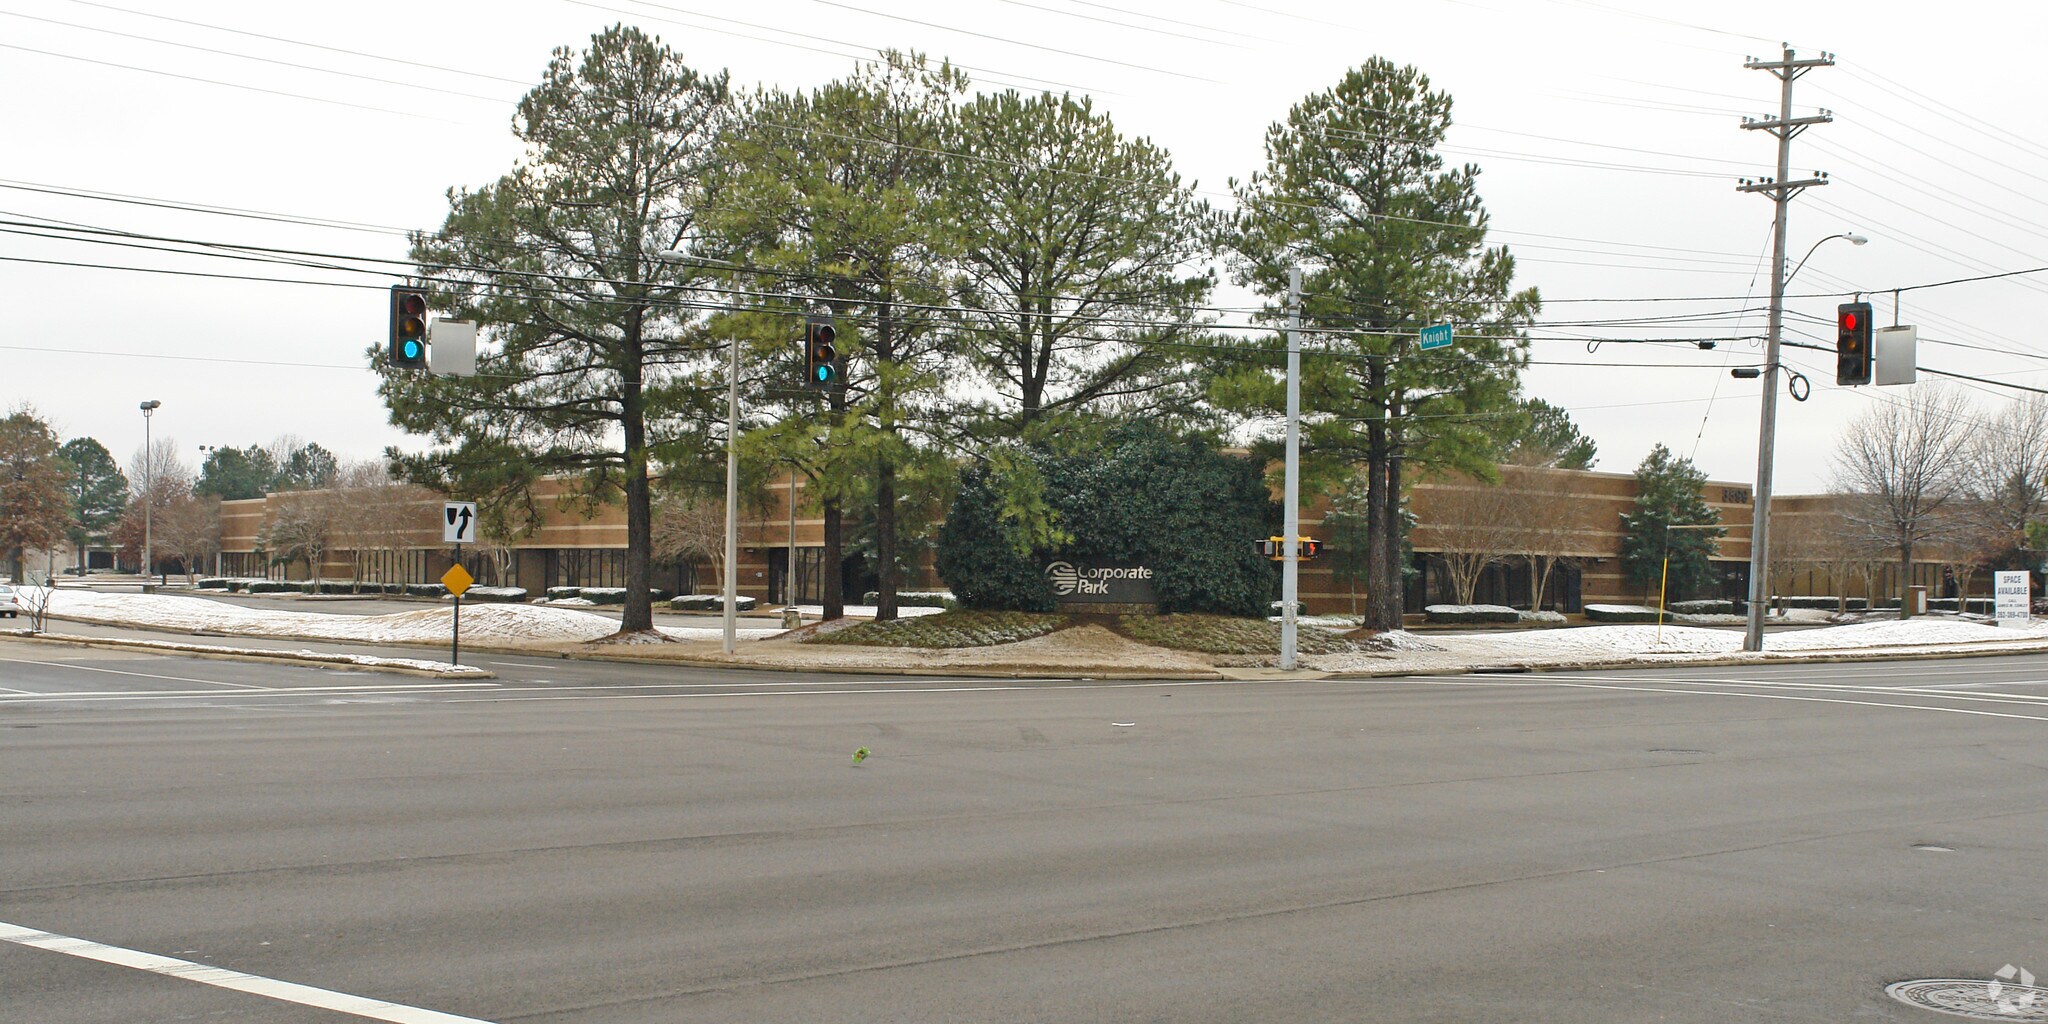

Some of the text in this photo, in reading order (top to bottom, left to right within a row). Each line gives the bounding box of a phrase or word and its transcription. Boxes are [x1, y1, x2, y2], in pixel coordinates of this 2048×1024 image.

[1422, 329, 1449, 346] Knight
[1077, 565, 1153, 581] Corporate
[2003, 575, 2022, 584] SPACE
[1077, 579, 1109, 595] Park
[1997, 587, 2028, 595] AVAILABLE
